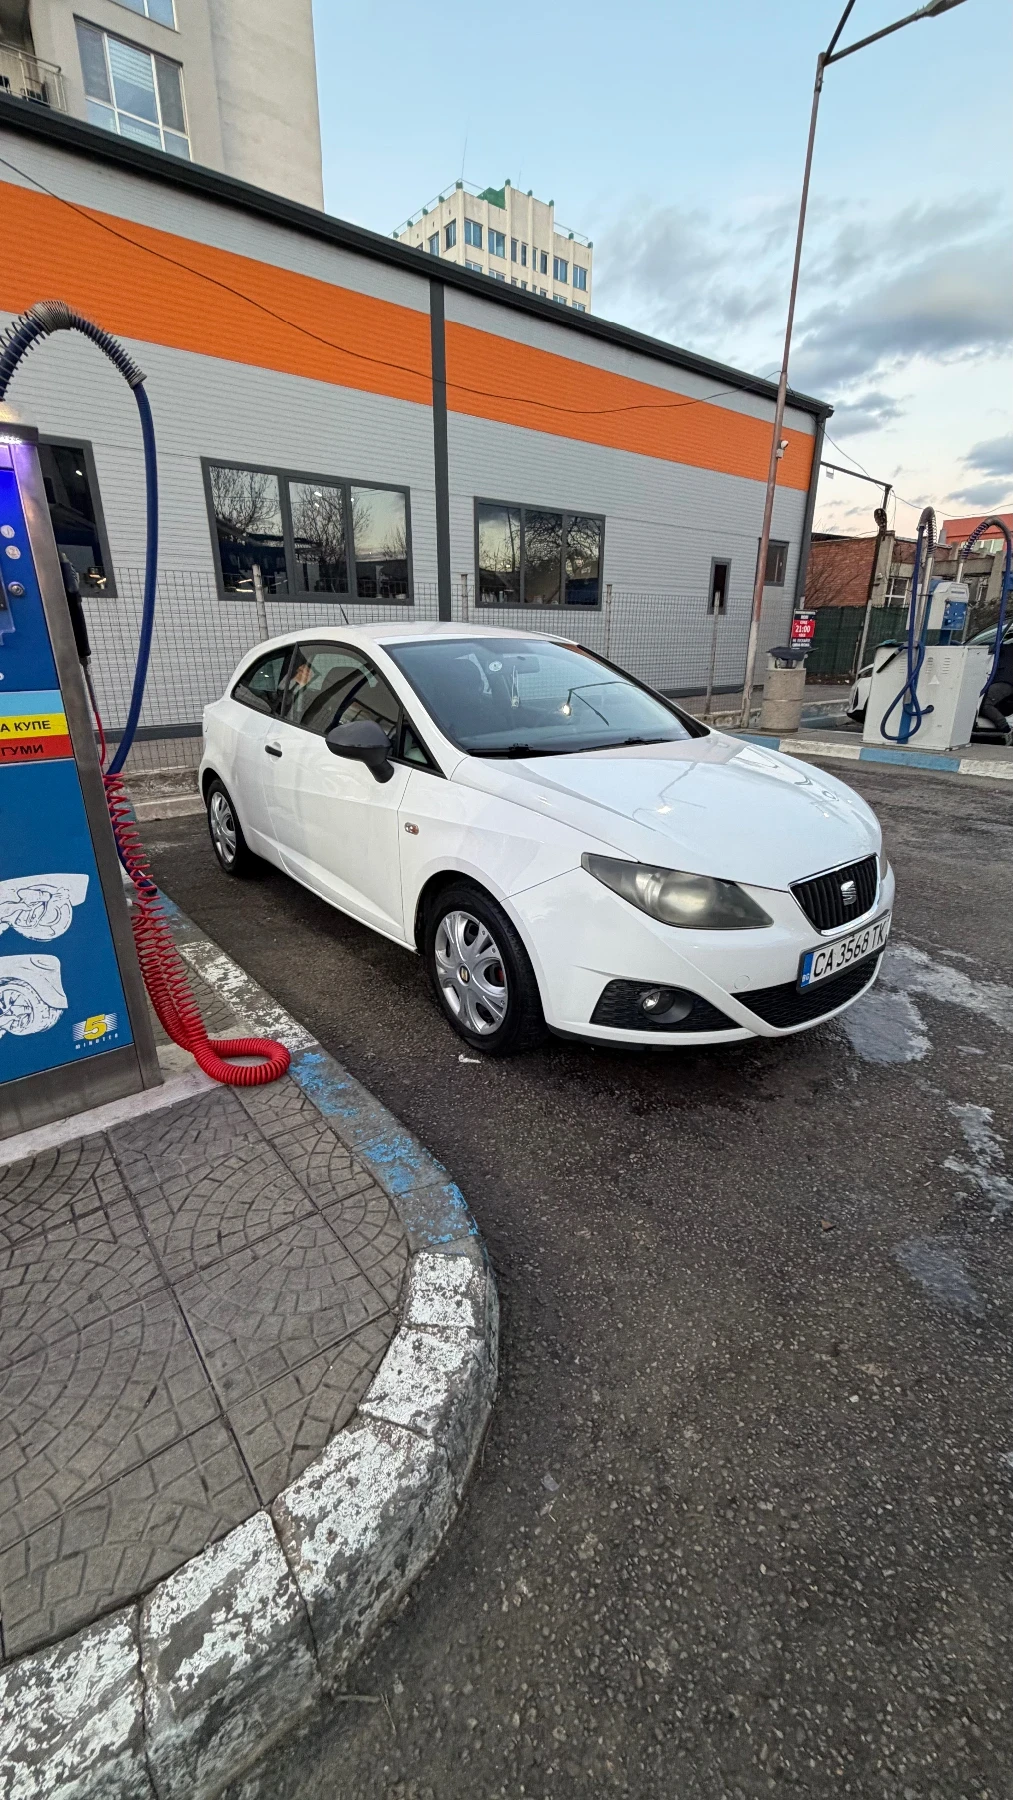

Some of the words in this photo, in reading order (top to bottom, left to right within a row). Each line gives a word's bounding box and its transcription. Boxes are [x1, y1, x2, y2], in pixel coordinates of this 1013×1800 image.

[795, 625, 811, 633] 21:00
[13, 720, 52, 731] КУПЕ
[0, 744, 44, 756] ГУМИ
[813, 948, 834, 977] CA
[836, 931, 869, 967] 3568
[872, 921, 887, 948] TK
[82, 1013, 107, 1040] 5
